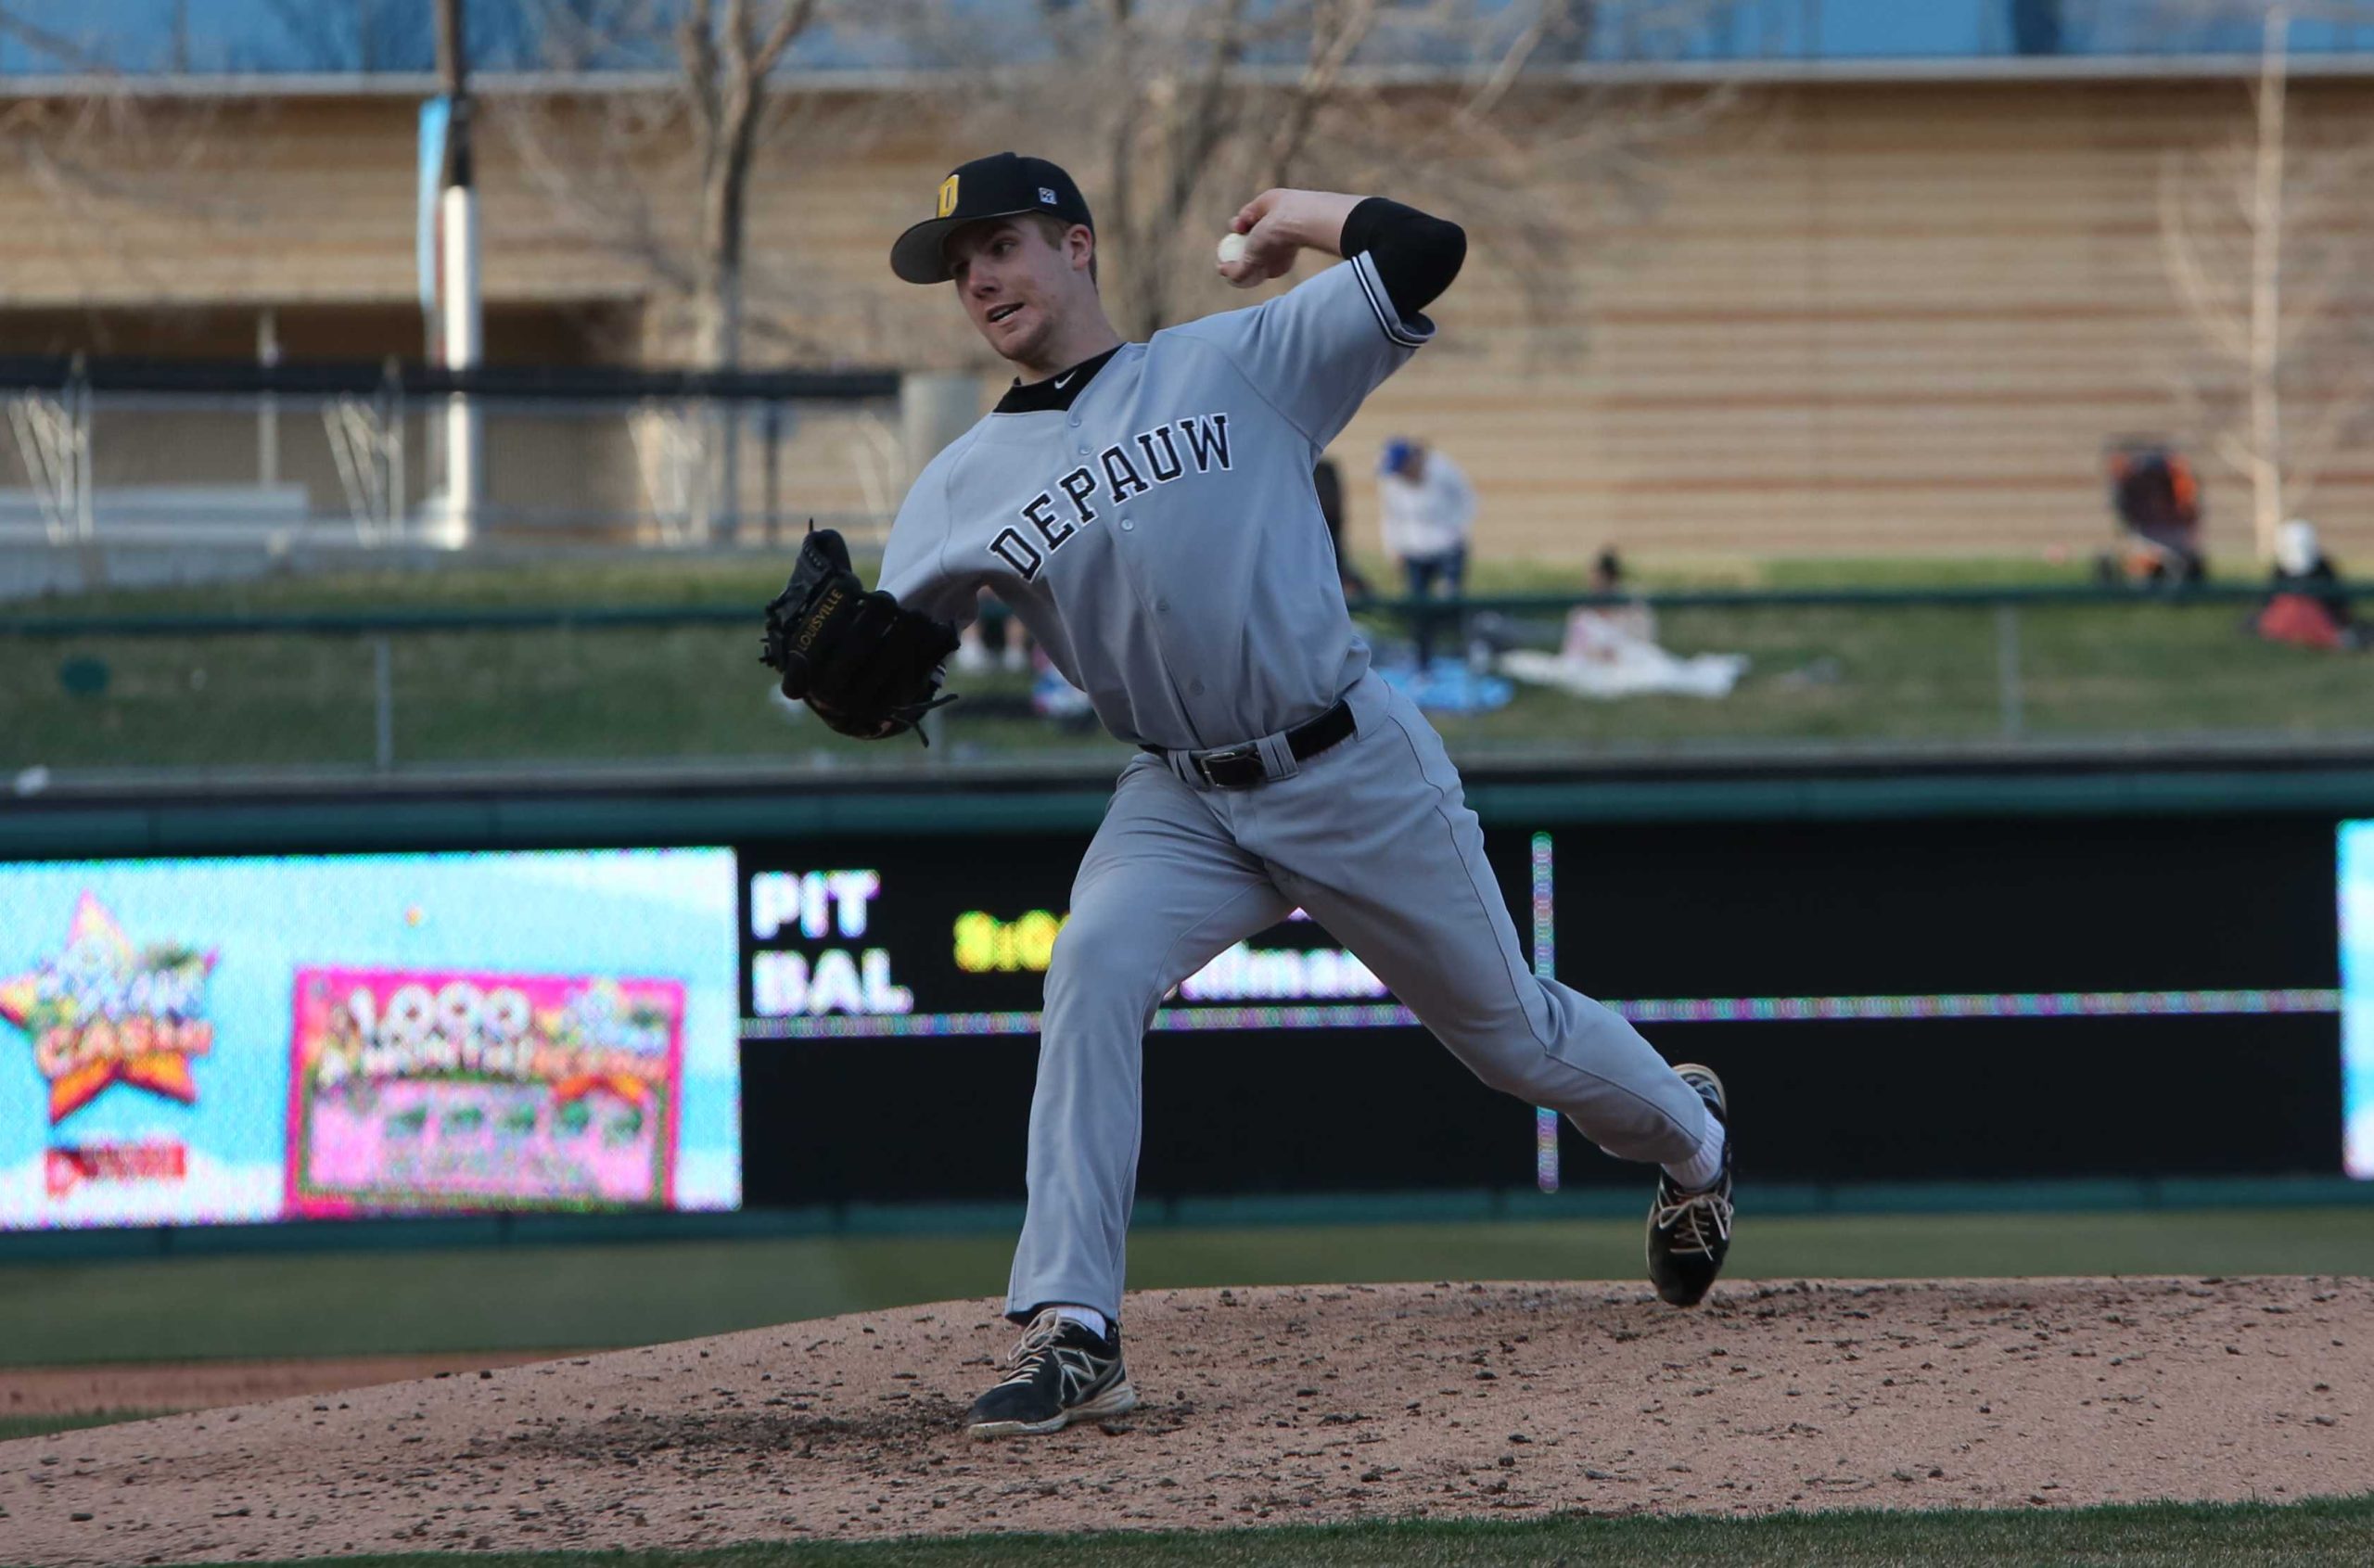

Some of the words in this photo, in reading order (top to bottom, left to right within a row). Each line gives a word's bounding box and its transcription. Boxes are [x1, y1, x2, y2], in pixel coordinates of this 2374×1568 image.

[937, 174, 959, 218] D
[987, 413, 1232, 583] DEPAUW
[798, 588, 844, 651] LOUISVILLE
[751, 870, 879, 938] PIT
[752, 949, 913, 1015] BAL
